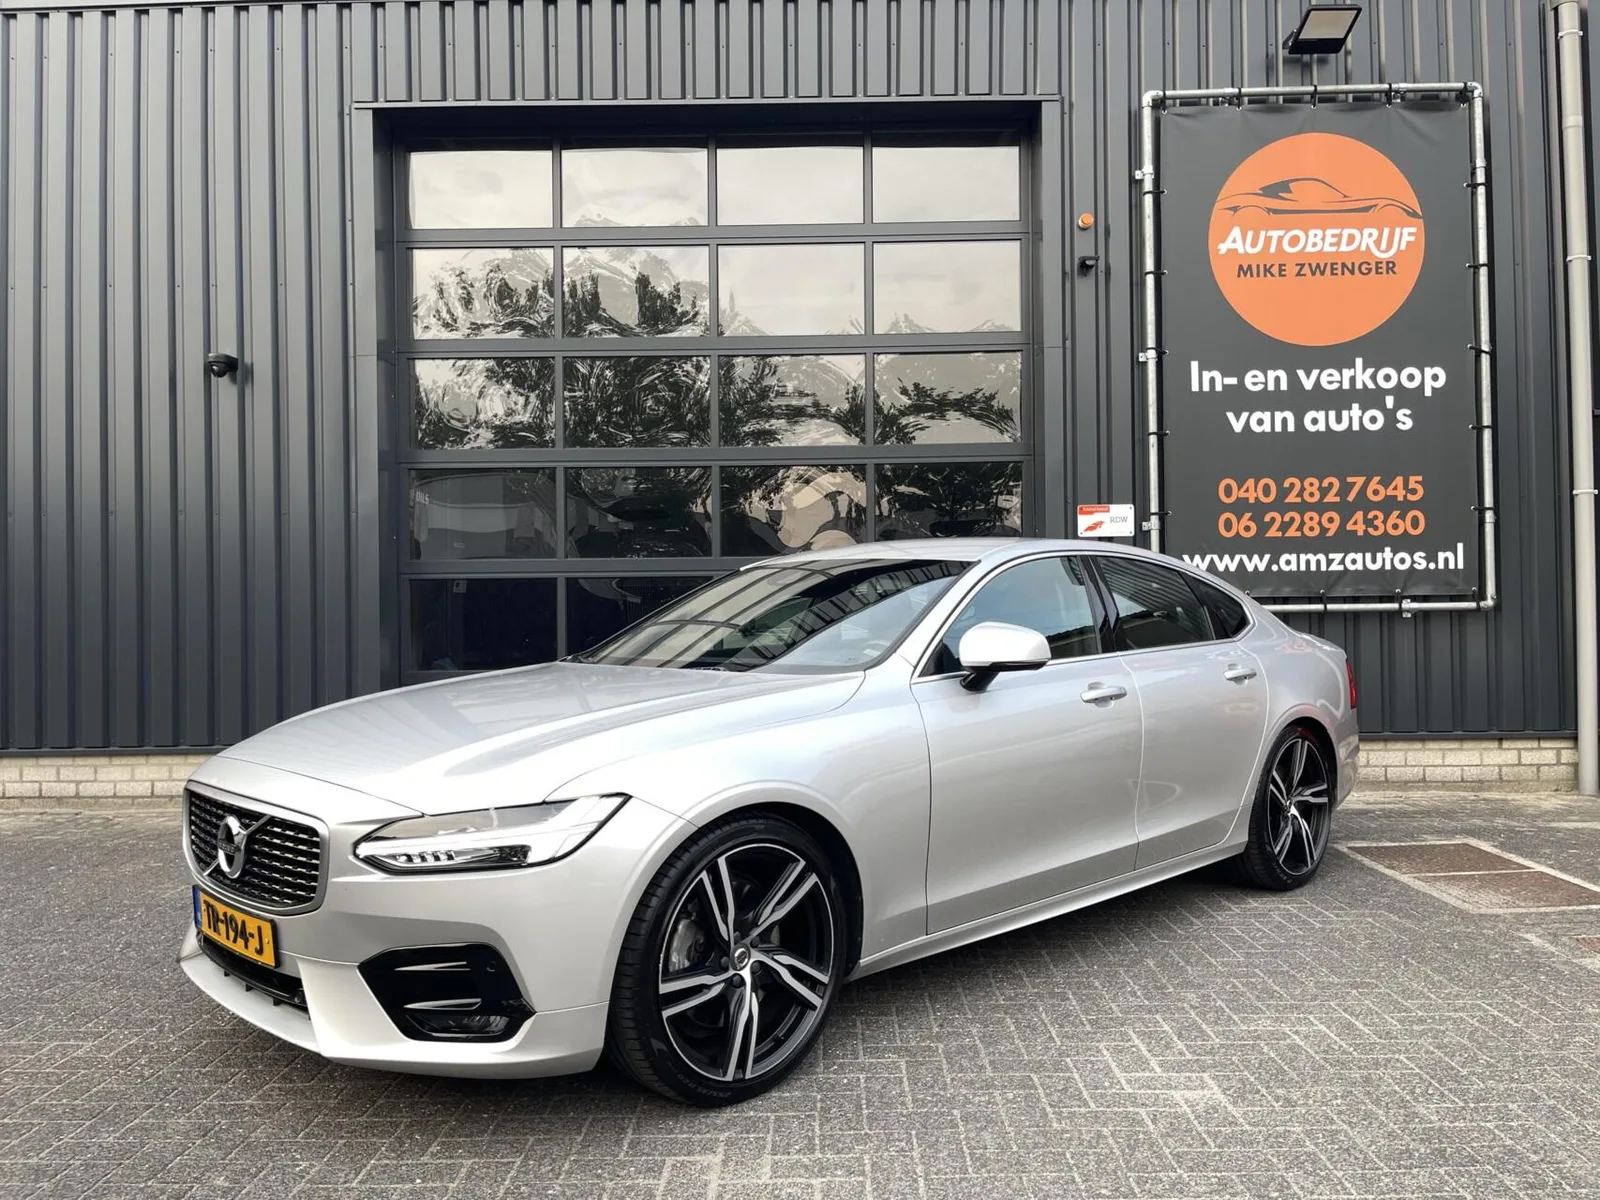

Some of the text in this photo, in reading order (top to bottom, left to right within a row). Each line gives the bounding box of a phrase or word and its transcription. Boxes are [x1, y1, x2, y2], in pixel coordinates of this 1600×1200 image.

[1217, 226, 1417, 259] AUTOBEDRIJF
[1236, 260, 1397, 278] MIKE ZWENGER
[1190, 357, 1447, 397] In- en verkoop
[1225, 395, 1413, 433] van auto's
[1217, 475, 1425, 504] 040 282 7645
[1217, 509, 1426, 538] 06 2289 4360
[1182, 542, 1464, 572] www.amzautos.nl
